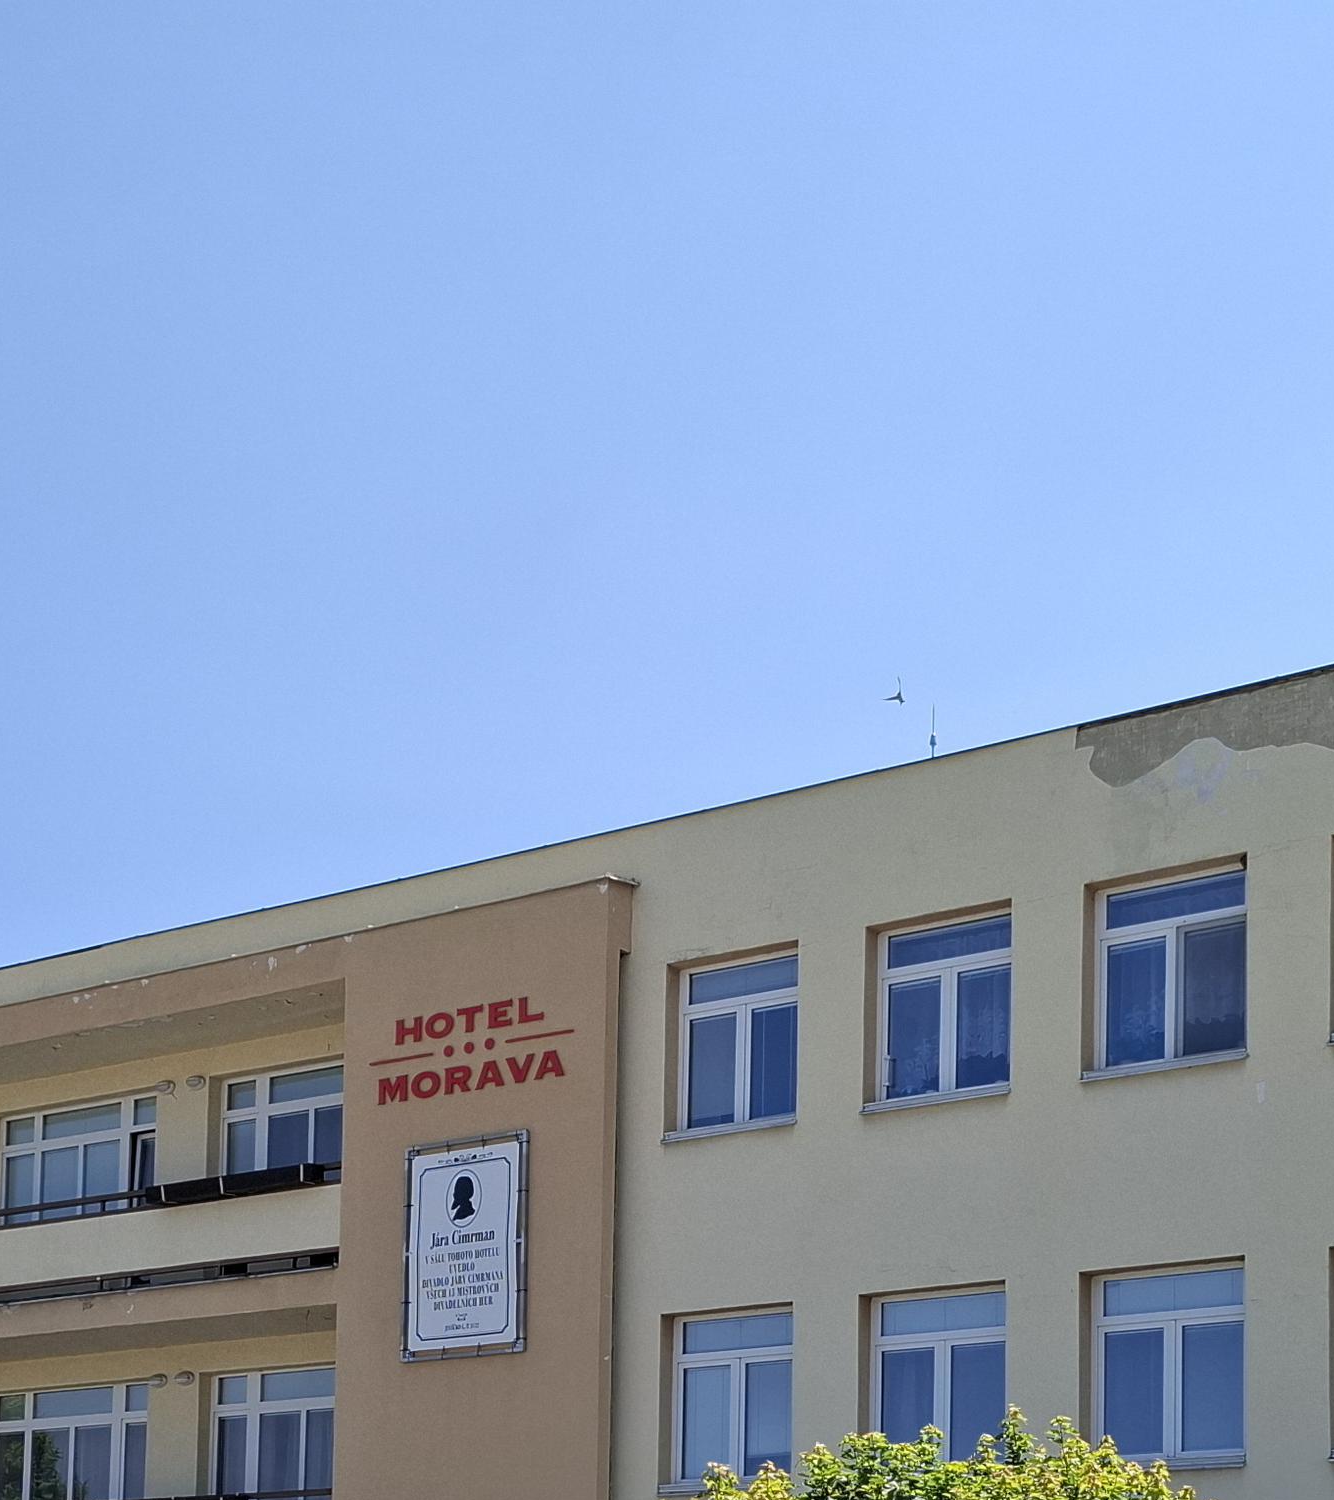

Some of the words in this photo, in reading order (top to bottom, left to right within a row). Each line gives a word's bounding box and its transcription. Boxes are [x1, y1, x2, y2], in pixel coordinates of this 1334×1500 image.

[395, 996, 544, 1046] HOTEL
[377, 1050, 565, 1105] MORAVA
[430, 1232, 449, 1250] Jára
[452, 1230, 495, 1245] Cimrman
[448, 1250, 473, 1262] TOHOTO
[449, 1262, 475, 1274] UVEDLO
[422, 1276, 449, 1288] DIVADLO
[468, 1270, 503, 1284] CIMRMANA
